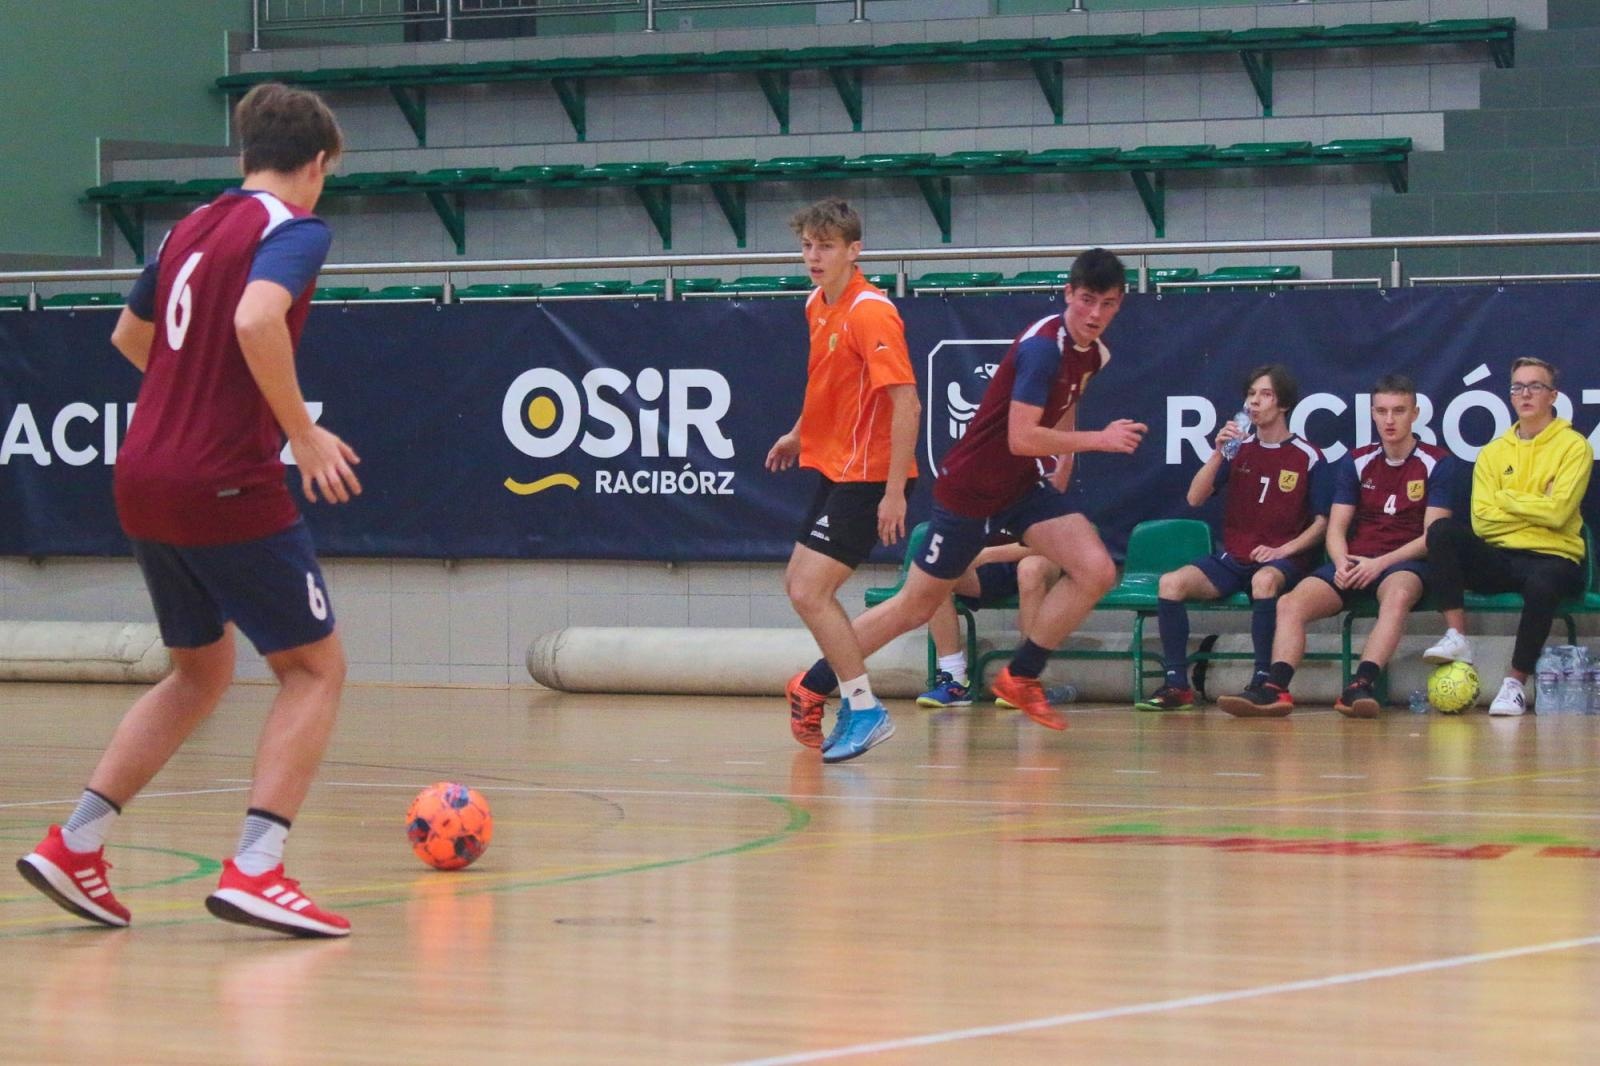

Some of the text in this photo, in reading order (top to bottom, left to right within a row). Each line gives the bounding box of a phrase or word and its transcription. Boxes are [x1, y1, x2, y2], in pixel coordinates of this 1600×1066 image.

[166, 252, 204, 351] 6
[502, 367, 735, 459] OSiR
[595, 463, 735, 495] RACIBÓRZ
[1258, 476, 1271, 504] 7
[1383, 494, 1397, 516] 4
[924, 533, 945, 565] 5
[306, 571, 327, 621] 6
